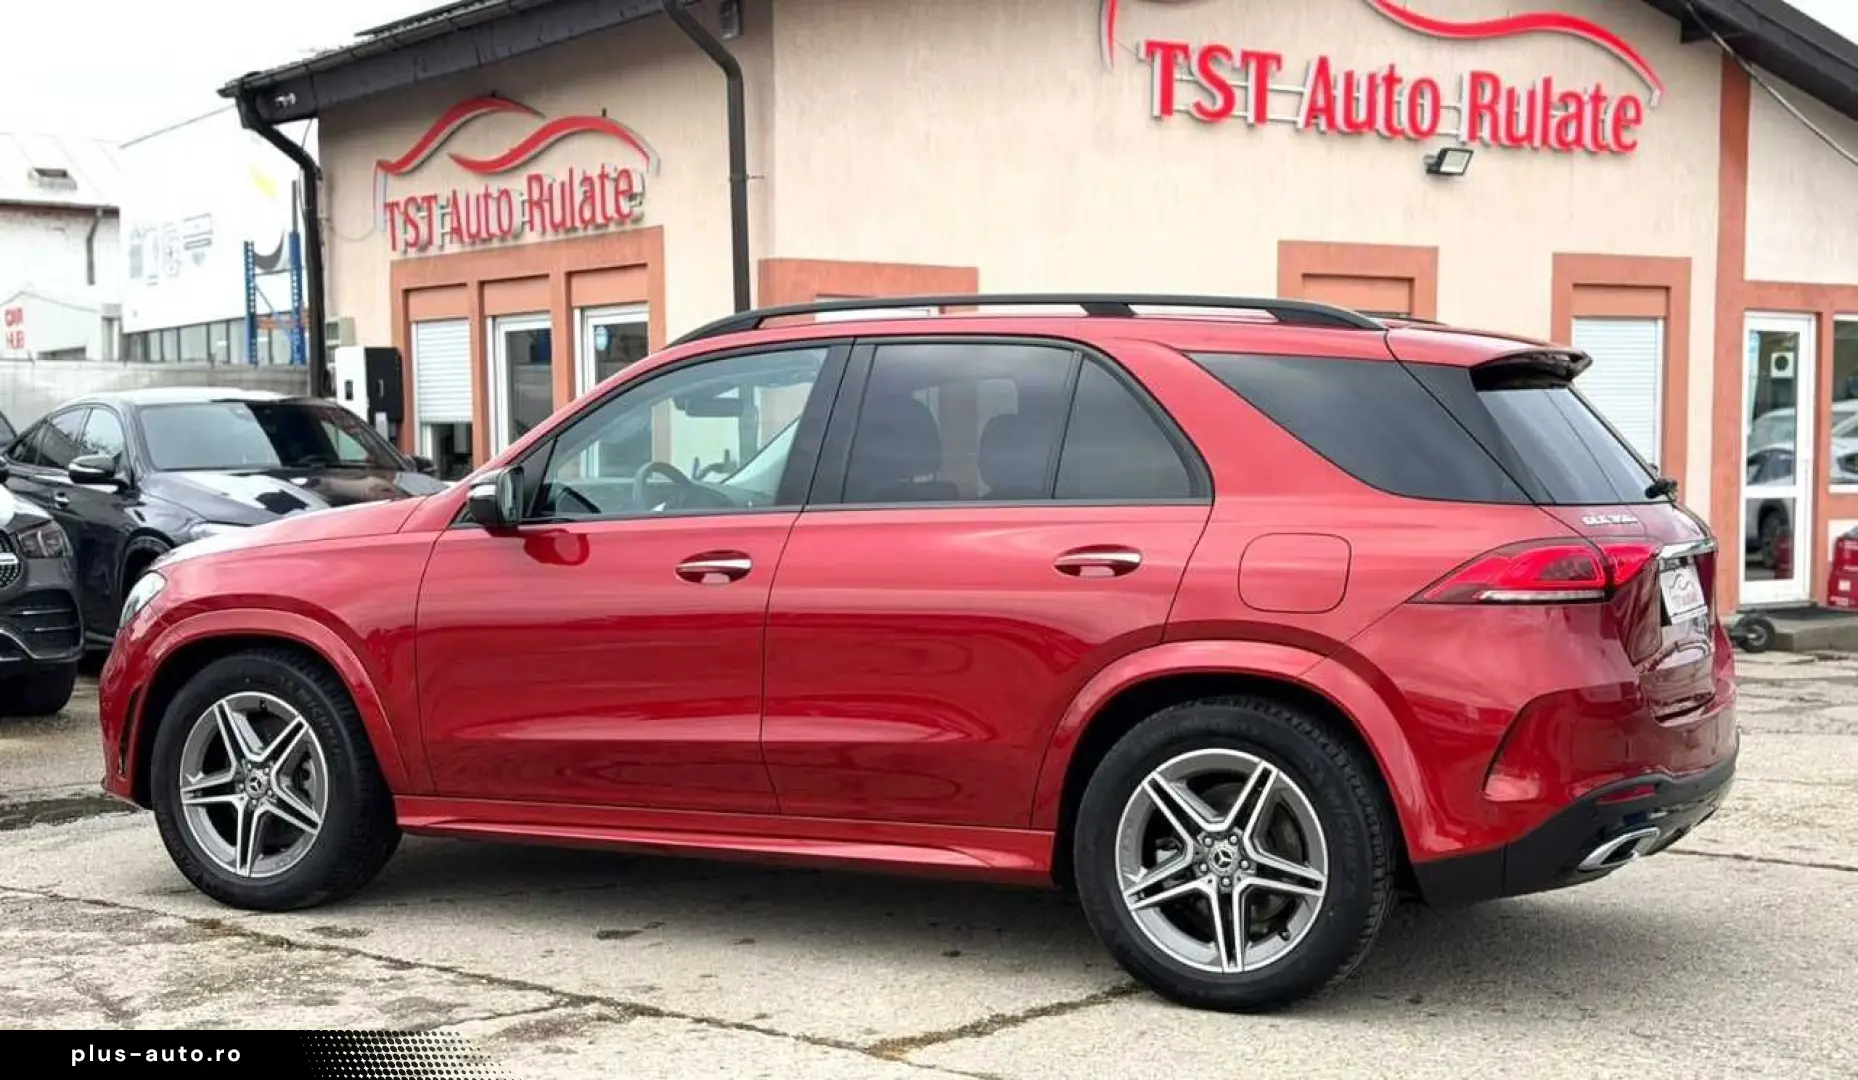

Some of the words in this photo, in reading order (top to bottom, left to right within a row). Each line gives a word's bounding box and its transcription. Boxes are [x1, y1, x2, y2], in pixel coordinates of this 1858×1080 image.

[1144, 40, 1282, 124] TST
[1299, 55, 1442, 141] Auto
[1463, 70, 1643, 155] Rulate
[384, 193, 439, 254] TST
[449, 183, 518, 247] Auto
[525, 162, 638, 234] Rulate
